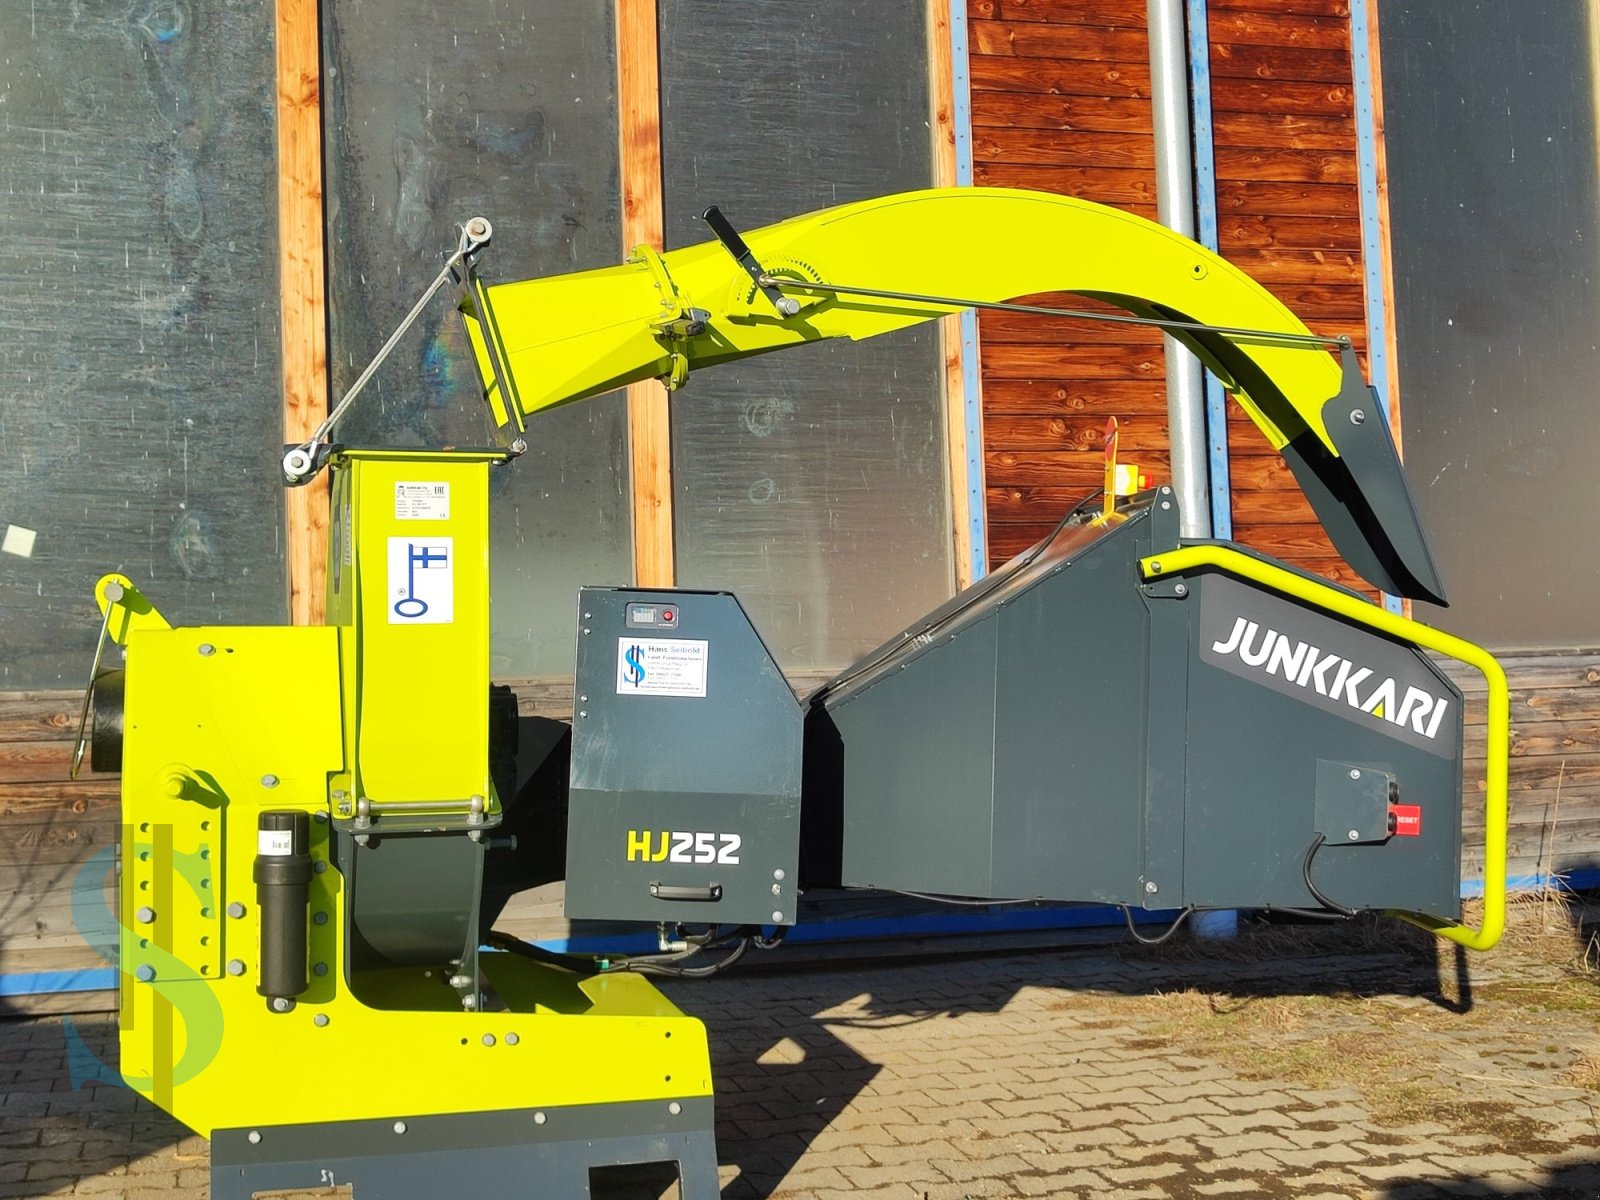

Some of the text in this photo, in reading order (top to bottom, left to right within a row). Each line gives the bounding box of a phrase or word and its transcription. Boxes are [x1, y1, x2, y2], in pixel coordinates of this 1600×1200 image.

[648, 645, 701, 654] Hans Seibold
[1211, 616, 1449, 739] JUNKKARI
[626, 830, 742, 865] HJ252
